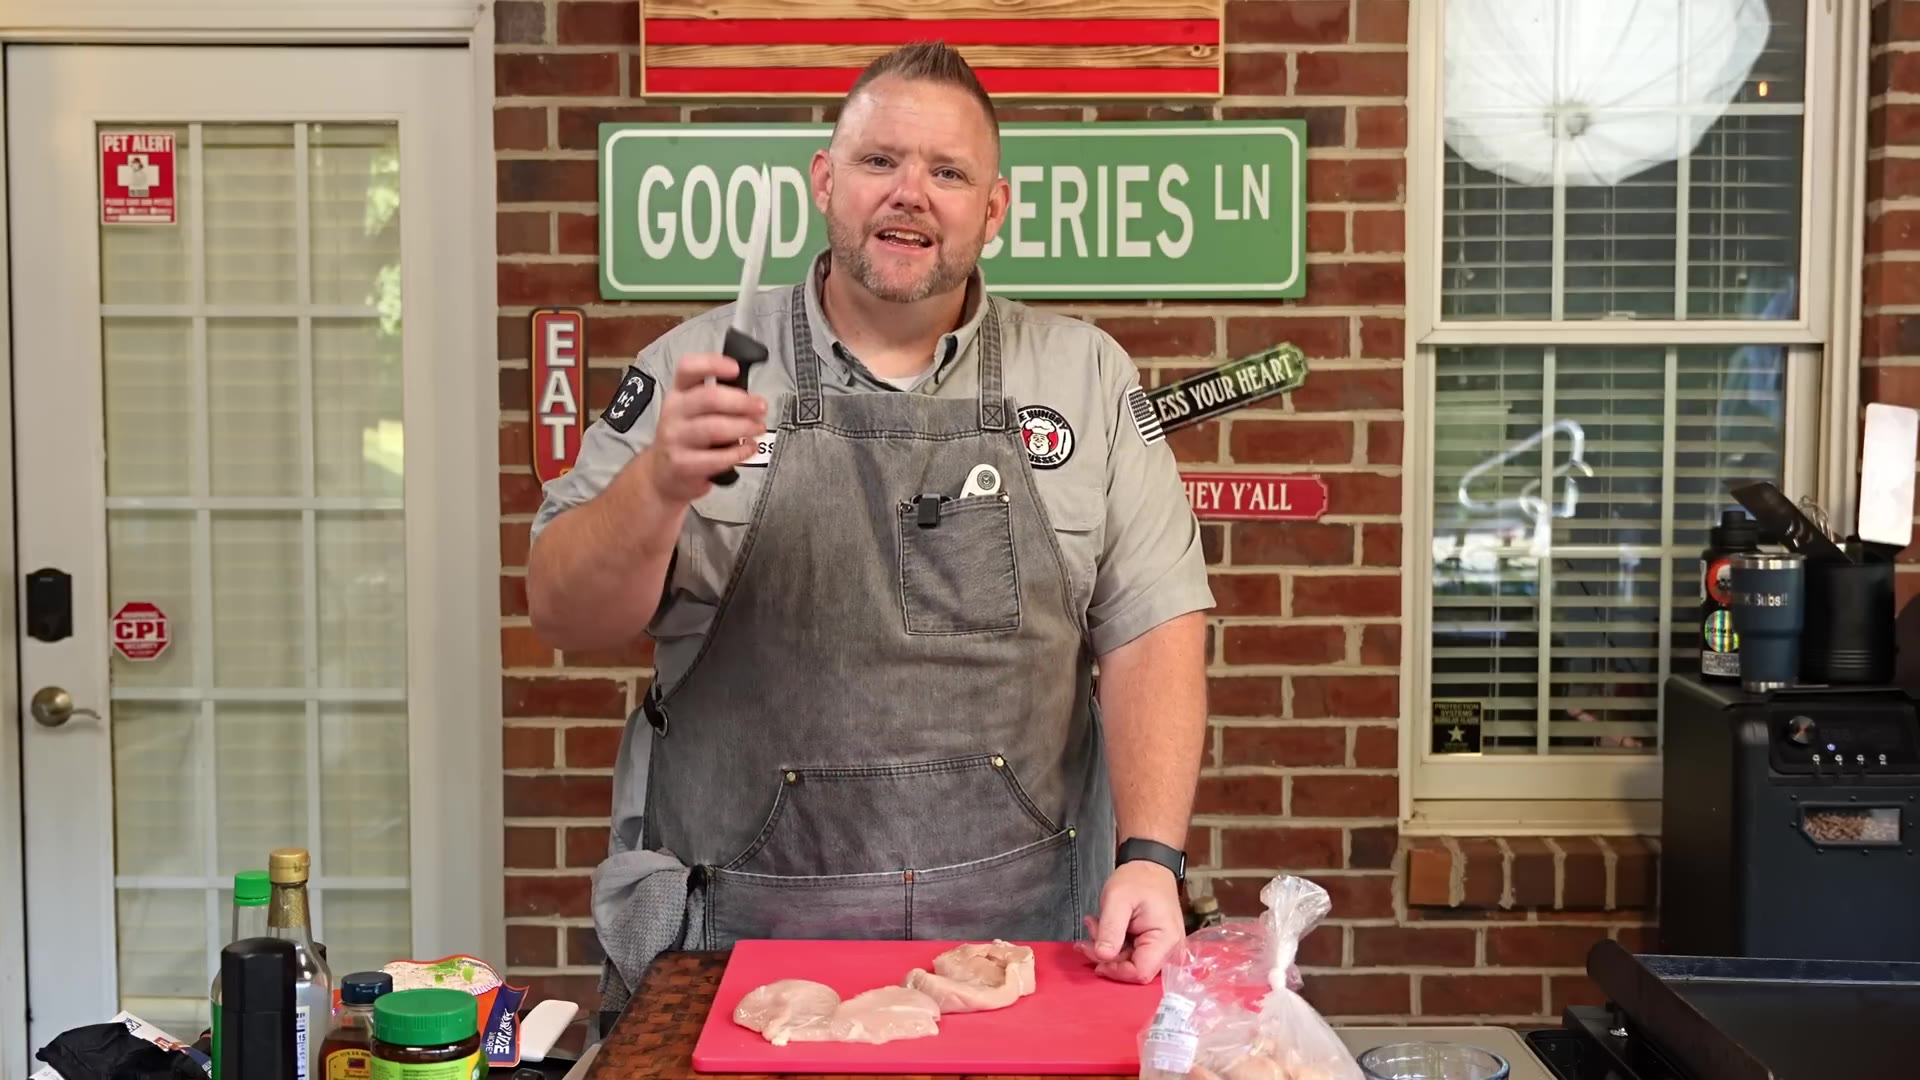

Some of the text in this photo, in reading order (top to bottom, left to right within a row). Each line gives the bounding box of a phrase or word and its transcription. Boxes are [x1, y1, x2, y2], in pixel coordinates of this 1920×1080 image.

[104, 135, 171, 152] PET ALERT
[637, 163, 809, 260] GOOD
[1215, 163, 1271, 221] LN
[539, 320, 578, 460] EAT
[1157, 353, 1295, 423] ESS YOUR HEART
[1026, 409, 1070, 430] HUNGRY
[1183, 481, 1293, 511] HEY Y'ALL
[116, 621, 165, 639] CPI
